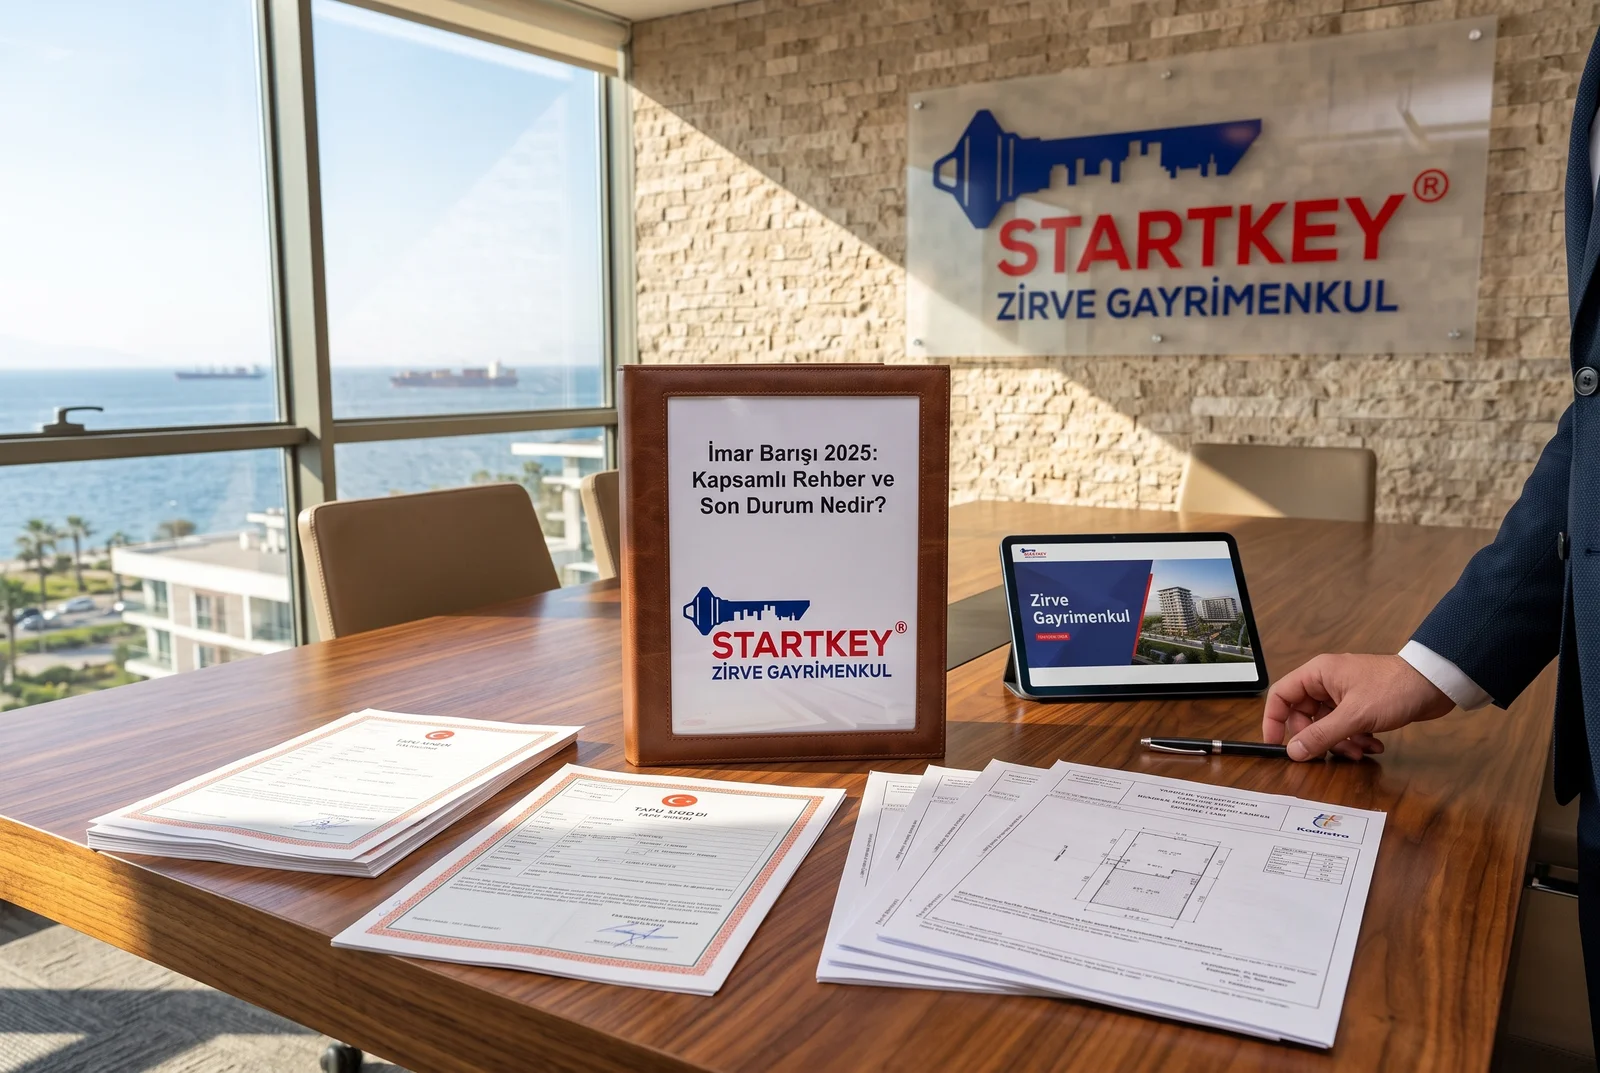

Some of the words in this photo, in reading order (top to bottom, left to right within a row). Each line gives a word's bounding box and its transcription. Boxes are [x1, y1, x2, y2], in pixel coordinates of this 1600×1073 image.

[997, 194, 1406, 277] STARTKEY
[997, 282, 1096, 321] ZİRVE
[1106, 276, 1399, 319] GAYRİMENKUL
[708, 440, 753, 462] İmar
[760, 444, 818, 465] Barışı
[824, 444, 878, 462] 2025:
[692, 470, 786, 492] Kapsamlı
[793, 470, 866, 488] Rehber
[871, 474, 895, 488] ve
[700, 497, 740, 514] Son
[747, 497, 814, 514] Durum
[821, 495, 886, 513] Nedir?
[1030, 593, 1069, 607] Zirve
[1033, 609, 1130, 628] Gayrimenkul
[711, 629, 893, 659] STARTKEY
[711, 662, 763, 680] ZİRVE
[767, 660, 892, 679] GAYRİMENKUL
